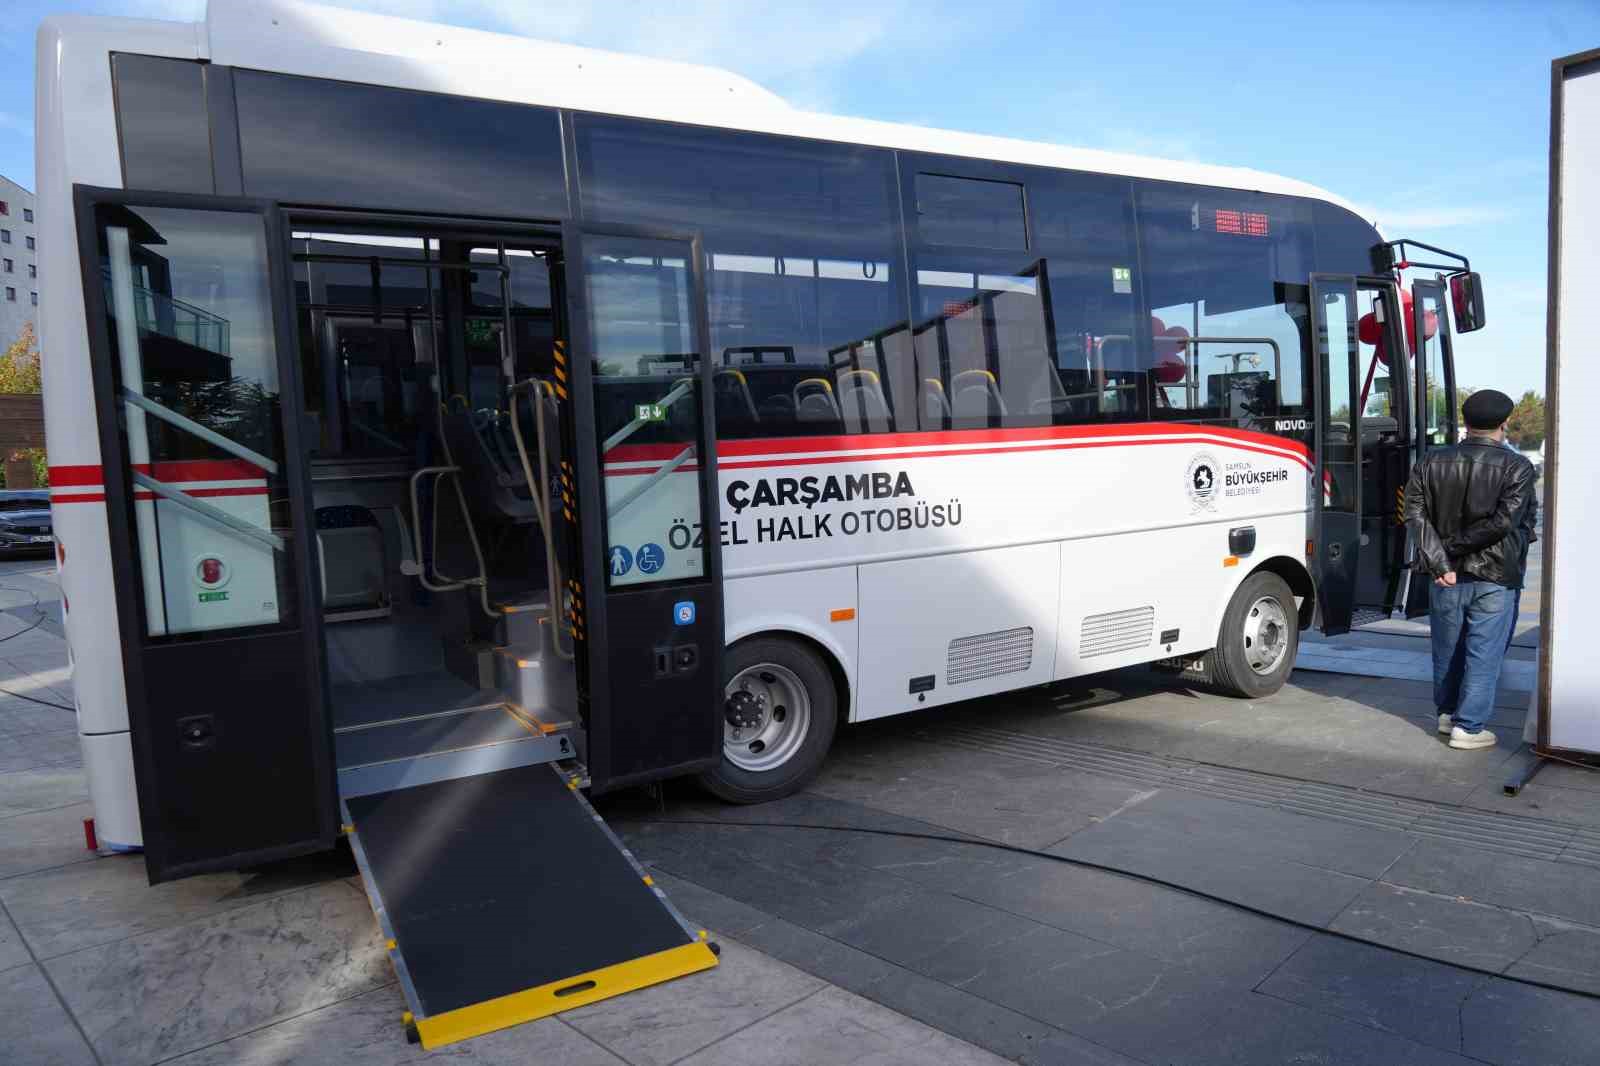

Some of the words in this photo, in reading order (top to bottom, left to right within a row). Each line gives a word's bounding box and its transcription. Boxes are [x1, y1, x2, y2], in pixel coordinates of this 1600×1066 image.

[726, 471, 915, 514] ÇARŞAMBA
[1225, 467, 1288, 487] BÜYÜKŞEHİR
[669, 518, 748, 550] ÖZEL
[757, 513, 833, 543] HALK
[841, 498, 962, 535] OTOBÜSÜ
